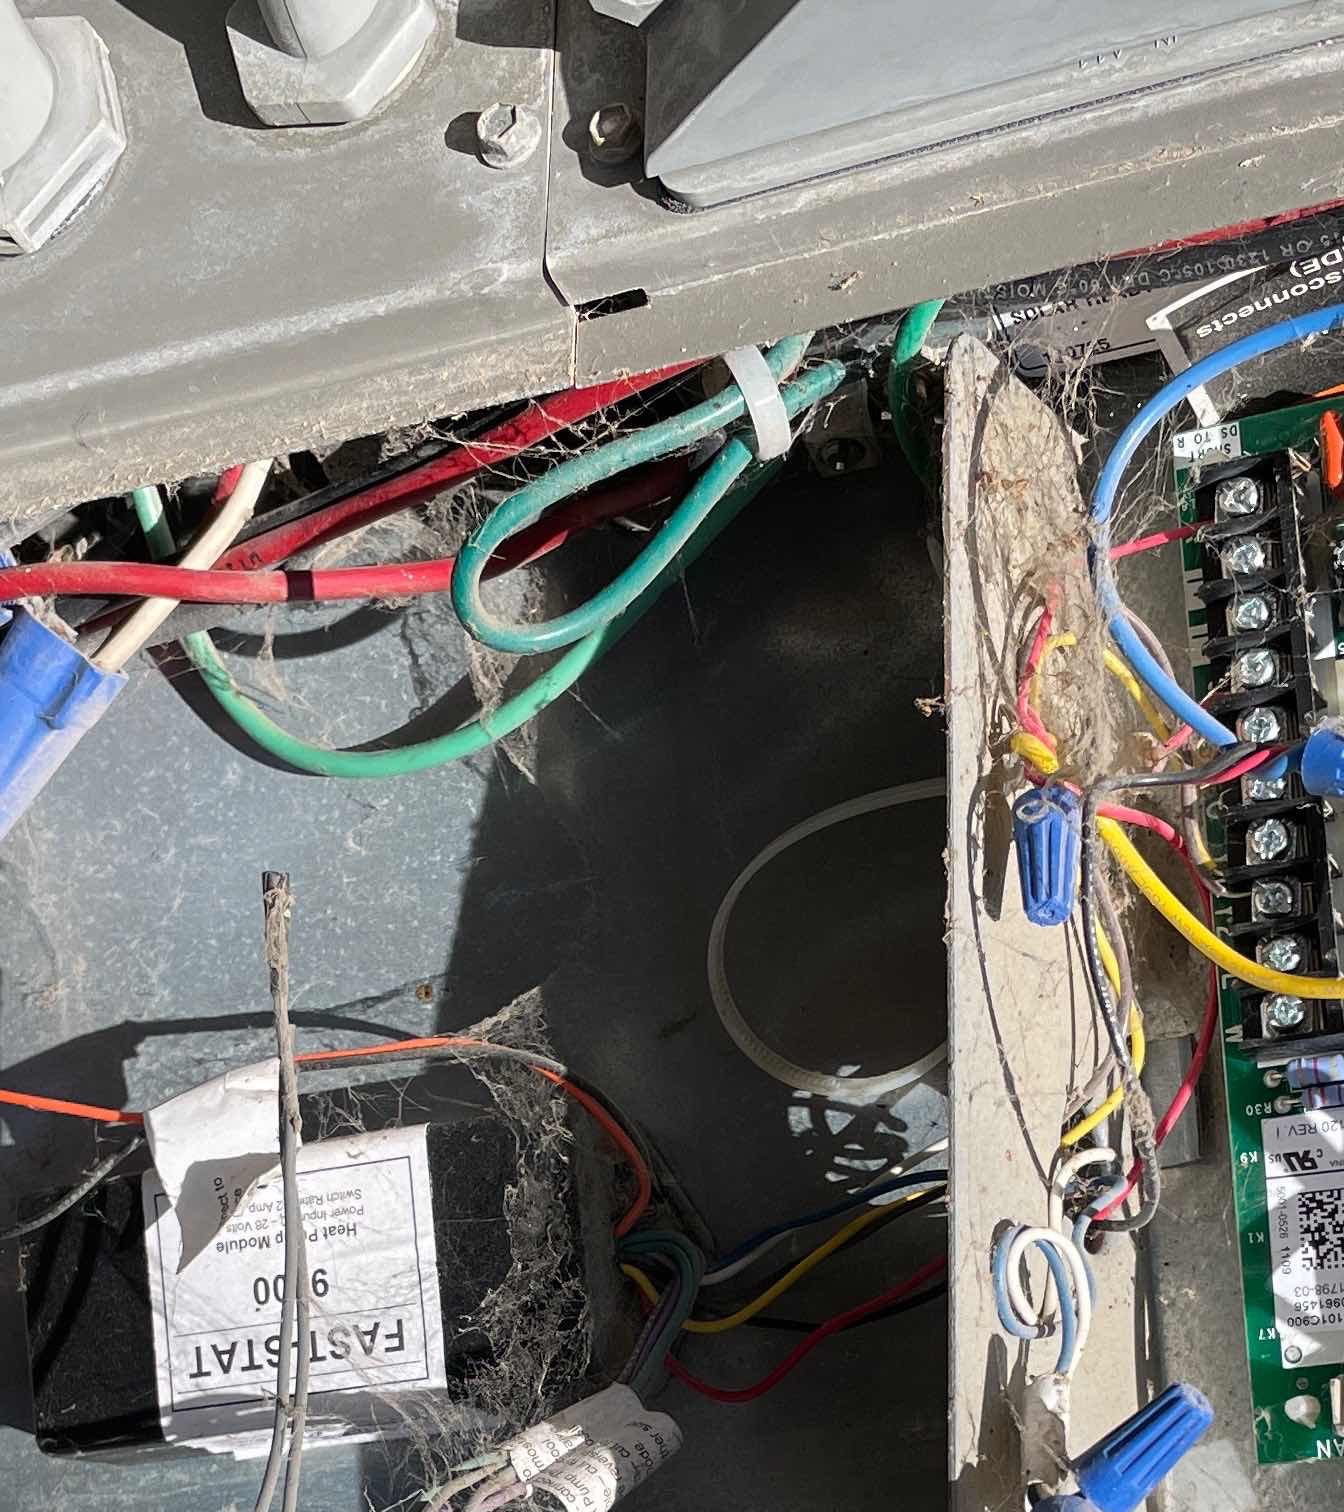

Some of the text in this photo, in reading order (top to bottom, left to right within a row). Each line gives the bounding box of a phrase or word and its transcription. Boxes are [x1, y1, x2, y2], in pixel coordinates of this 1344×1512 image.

[1220, 425, 1237, 439] DS
[1177, 437, 1185, 448] R
[1246, 1102, 1272, 1116] R30
[1239, 1152, 1258, 1164] K9
[325, 1189, 362, 1202] Switch
[330, 1205, 364, 1218] Power
[225, 1222, 252, 1234] Volts
[322, 1222, 357, 1240] Heat
[1247, 1232, 1264, 1243] K1
[214, 1234, 270, 1256] Module
[253, 1268, 330, 1306] 900
[1258, 1328, 1276, 1340] K7
